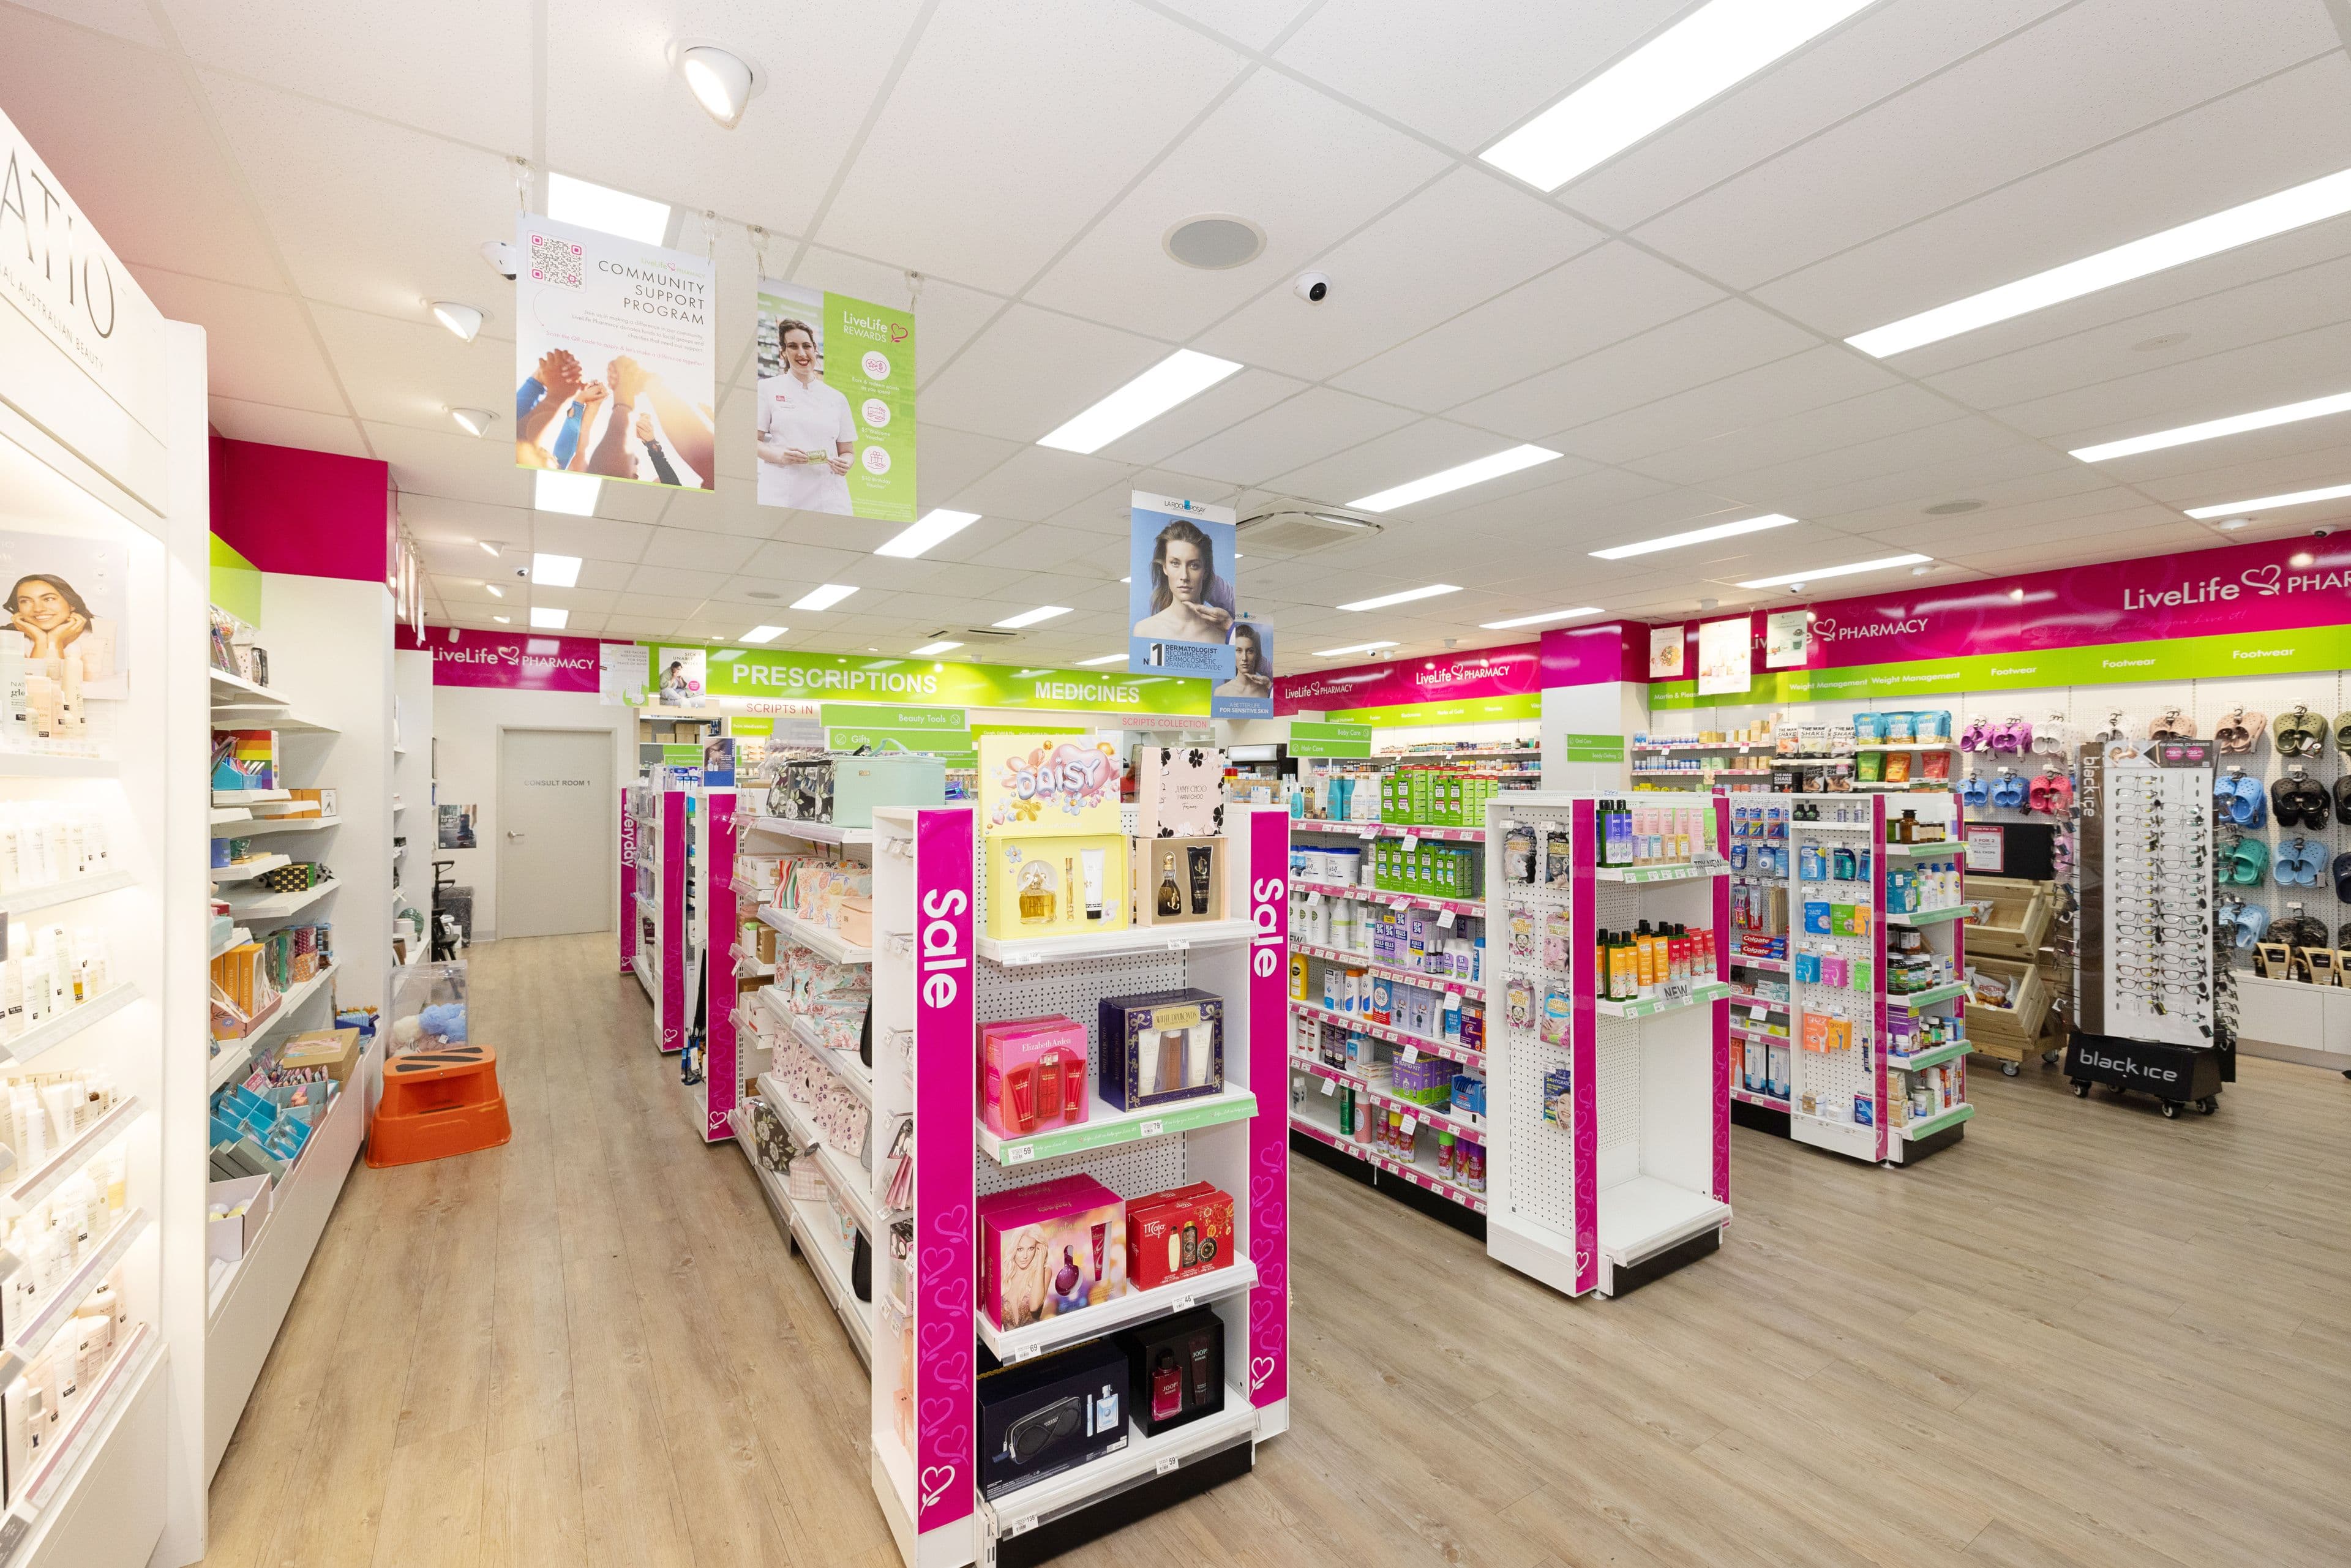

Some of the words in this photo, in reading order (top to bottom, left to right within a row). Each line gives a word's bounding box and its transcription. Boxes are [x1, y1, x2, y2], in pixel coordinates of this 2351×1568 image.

[598, 260, 705, 294] COMMUNITY
[636, 285, 705, 310] SUPPORT
[623, 298, 704, 325] PROGRAM
[18, 282, 73, 343] AUSTRALIAN
[76, 337, 103, 373] BEAUTY
[844, 310, 888, 333] LiveLife
[844, 324, 887, 343] REWARDS
[2123, 576, 2240, 610] LiveLife
[1839, 618, 1930, 640] PHARMACY
[1152, 643, 1163, 666] 1
[1165, 644, 1218, 655] DERMATOLOGIST
[1165, 650, 1212, 659] RECOMMENDED
[2232, 647, 2296, 659] Footwear
[430, 646, 499, 665] LiveLife
[522, 655, 594, 670] PHARMACY
[1165, 656, 1217, 665] DERMOCOSMETIC
[2102, 658, 2156, 669] Footwear
[732, 663, 938, 694] PRESCRIPTIONS
[1416, 669, 1452, 685] LiveLife
[1463, 665, 1510, 680] PHARMACY
[1872, 675, 1900, 685] Weight
[1902, 671, 1960, 685] Management
[1990, 666, 2038, 677] Footwear
[1035, 681, 1140, 703] MEDICINES
[1285, 685, 1311, 699] LiveLife
[1320, 683, 1354, 696] PHARMACY
[1789, 681, 1814, 692] Weight
[1815, 678, 1868, 690] Management
[746, 703, 797, 715] SCRIPTS
[801, 705, 814, 715] IN
[898, 713, 925, 724] Beauty
[926, 715, 947, 724] Tools
[1122, 717, 1155, 727] SCRIPTS
[1158, 718, 1207, 729] COLLECTION
[851, 734, 870, 744] Gifts
[2083, 756, 2100, 795] black
[1174, 785, 1190, 793] JIMMY
[1190, 784, 1207, 793] CHOO
[2083, 797, 2095, 817] ice
[1253, 877, 1284, 978] Sale
[1742, 935, 1770, 944] Colgate
[922, 888, 968, 1008] Sale
[1742, 945, 1770, 955] Colgate
[1663, 985, 1688, 1000] NEW
[1156, 1014, 1171, 1024] WHITE
[1171, 1012, 1197, 1023] DIAMONDS
[1021, 1041, 1051, 1052] Elizabeth
[1051, 1037, 1072, 1048] Arden
[1399, 1060, 1412, 1070] RAPID
[1412, 1063, 1421, 1071] KIT
[2079, 1048, 2138, 1078] black
[2143, 1060, 2178, 1082] ice
[1024, 1147, 1032, 1155] 59
[1144, 1220, 1166, 1239] Maja
[1029, 1343, 1038, 1352] 69
[1192, 1348, 1209, 1358] JOOP!
[1162, 1381, 1179, 1392] JOOP!
[1169, 1456, 1176, 1466] 59
